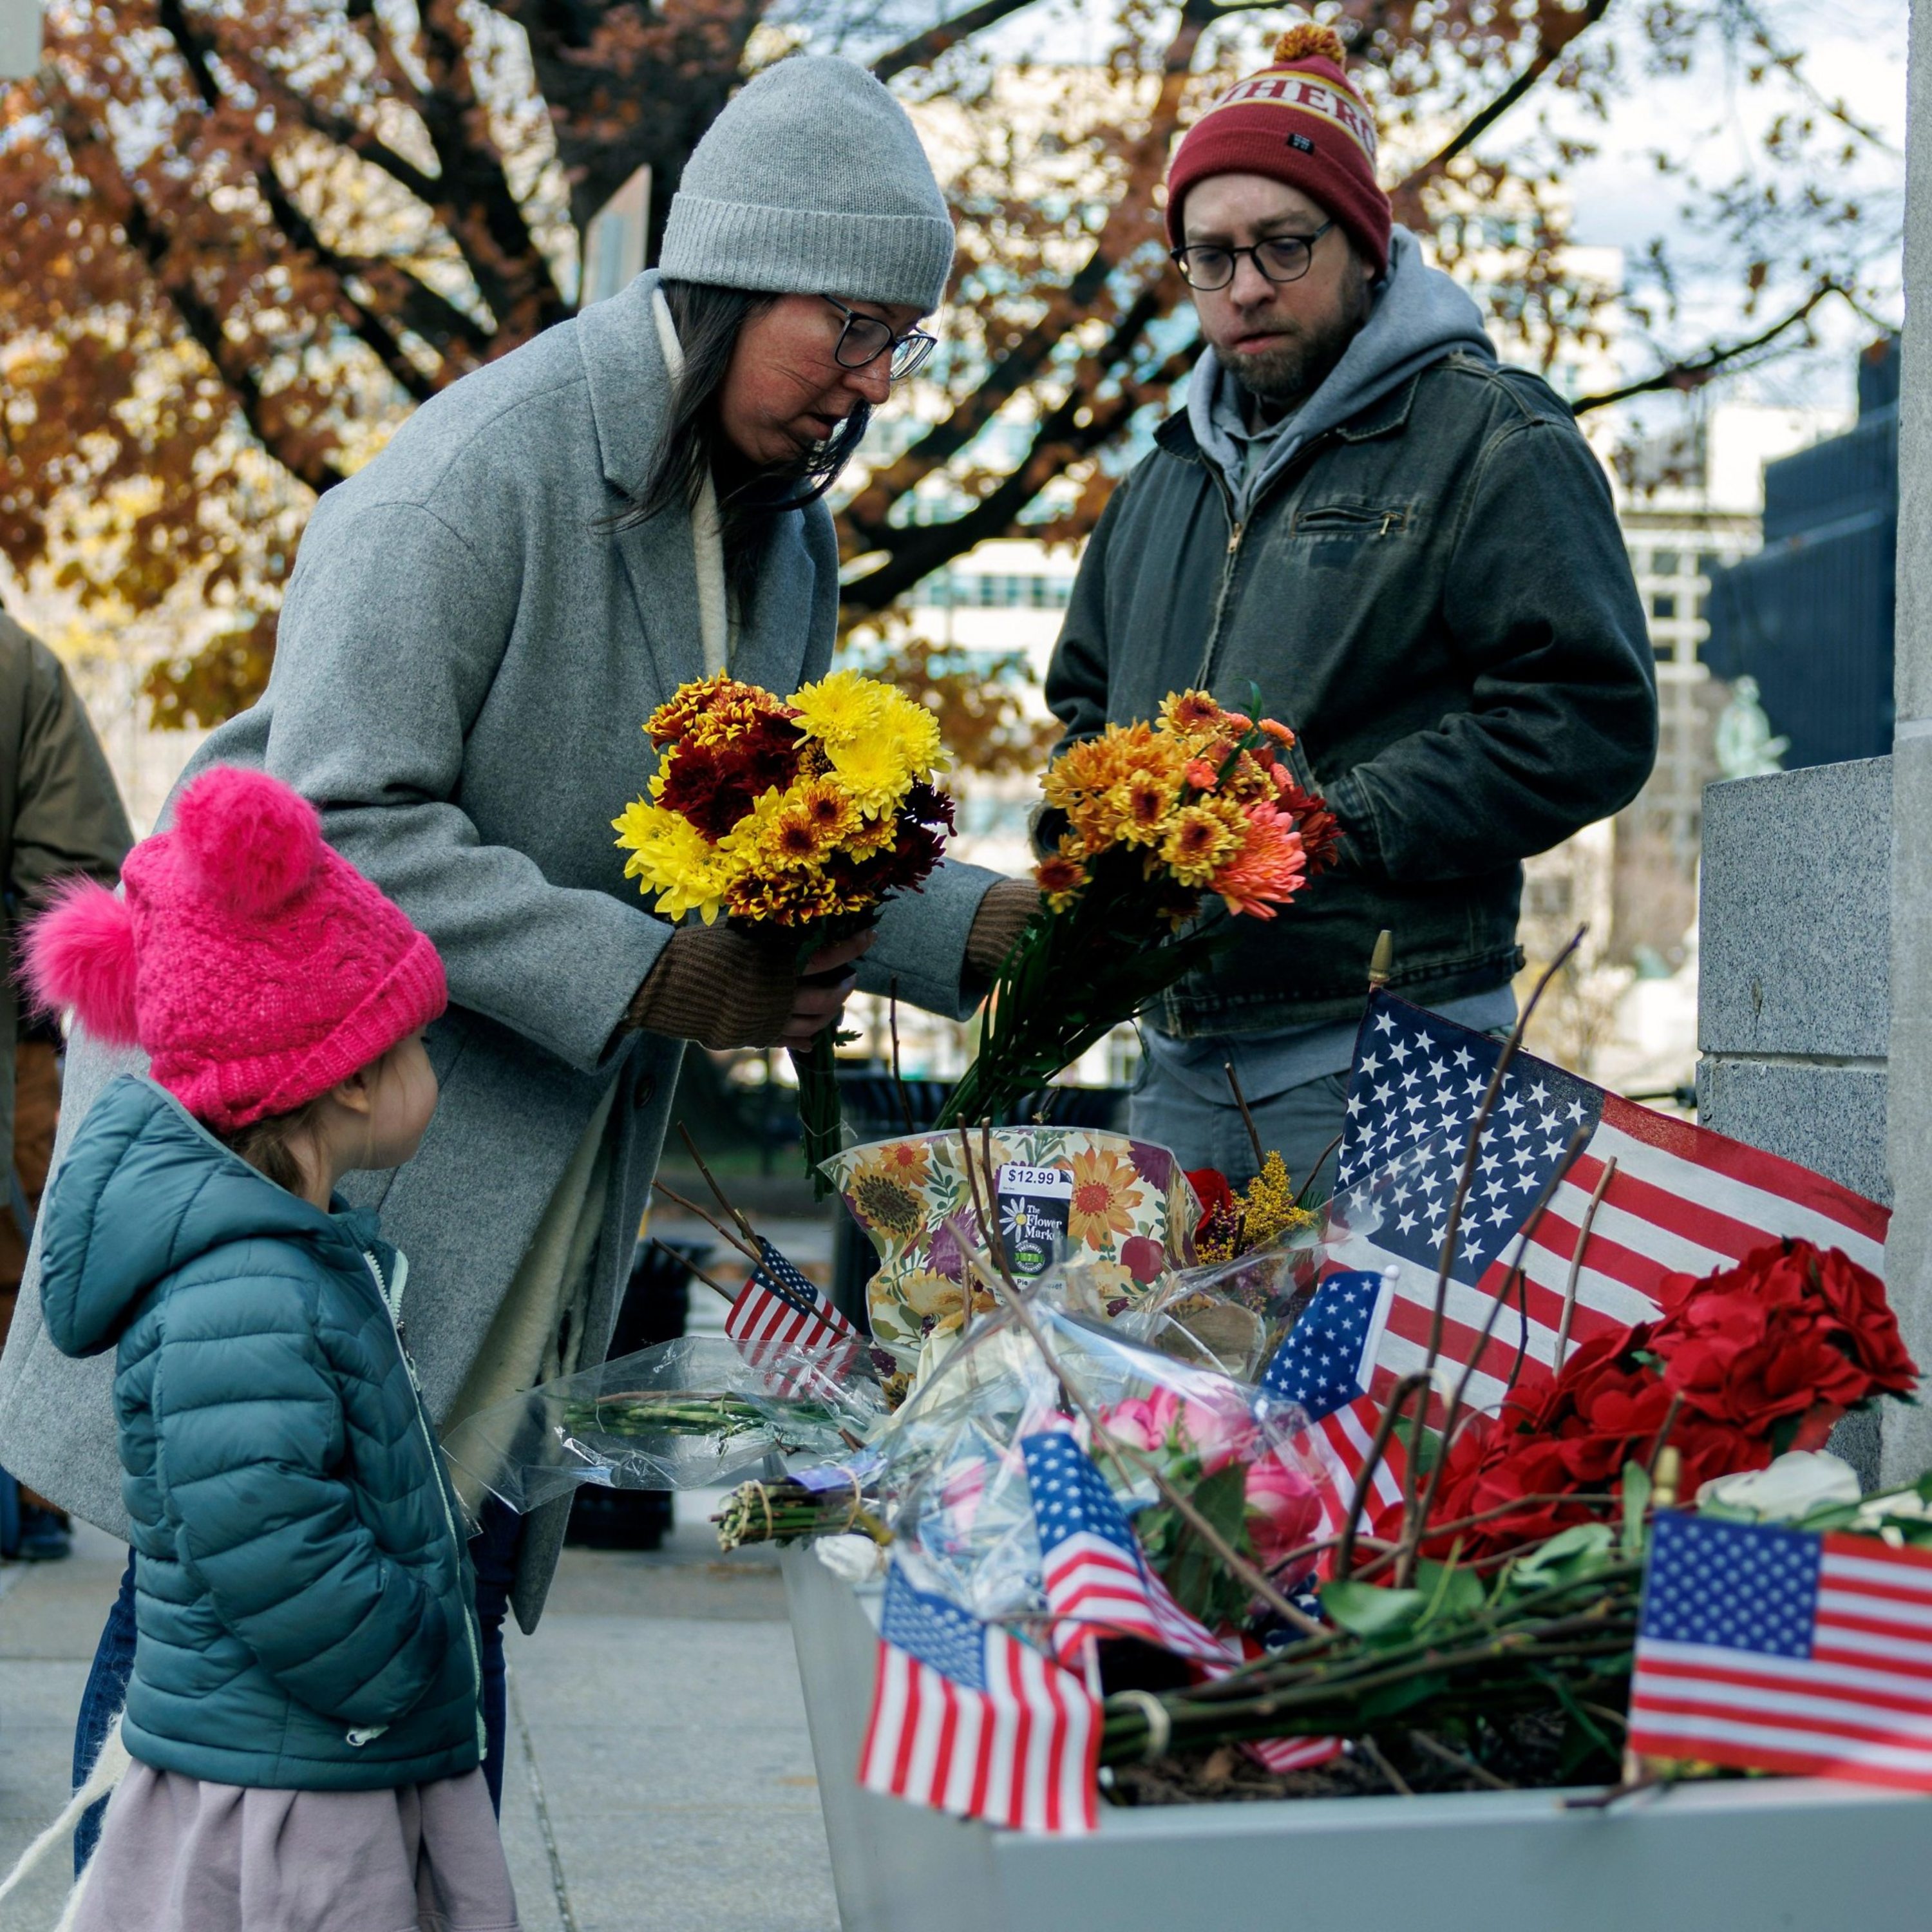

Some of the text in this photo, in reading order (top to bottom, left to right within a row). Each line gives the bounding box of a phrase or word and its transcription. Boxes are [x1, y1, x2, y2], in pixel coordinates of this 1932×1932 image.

[1008, 1169, 1054, 1184] $12.99
[1027, 1205, 1040, 1214] The
[1026, 1214, 1063, 1229] Flower
[1025, 1226, 1063, 1240] Mark
